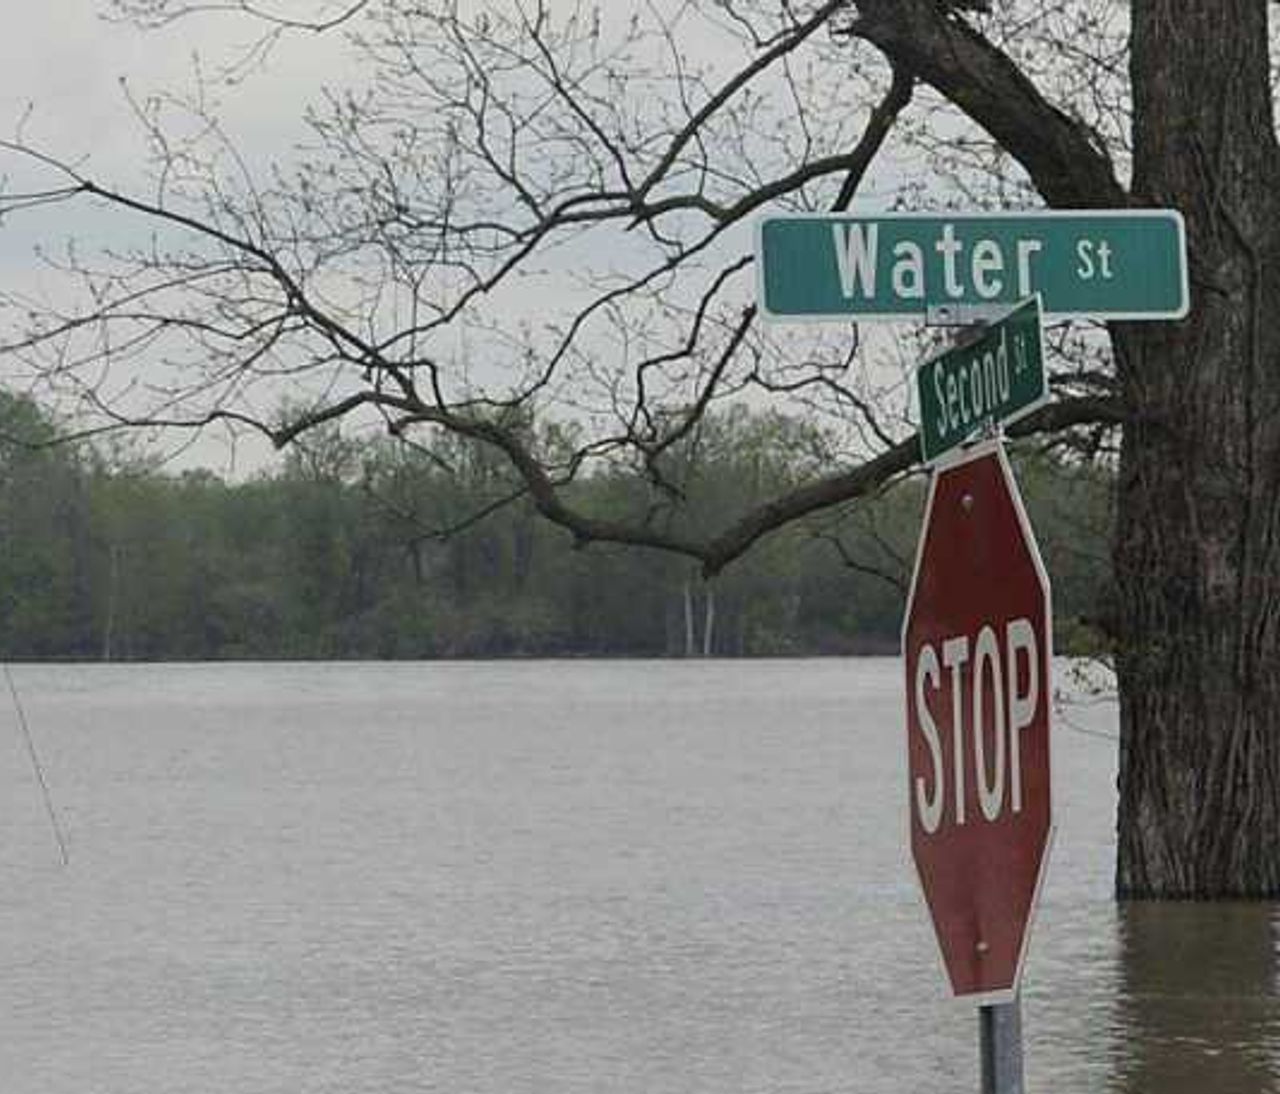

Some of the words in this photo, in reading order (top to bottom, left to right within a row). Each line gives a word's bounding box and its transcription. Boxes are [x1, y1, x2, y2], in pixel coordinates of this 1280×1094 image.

[831, 221, 1044, 299] Water
[1075, 238, 1115, 280] St
[933, 325, 1011, 438] Second
[1013, 330, 1028, 376] St
[915, 617, 1039, 835] STOP
